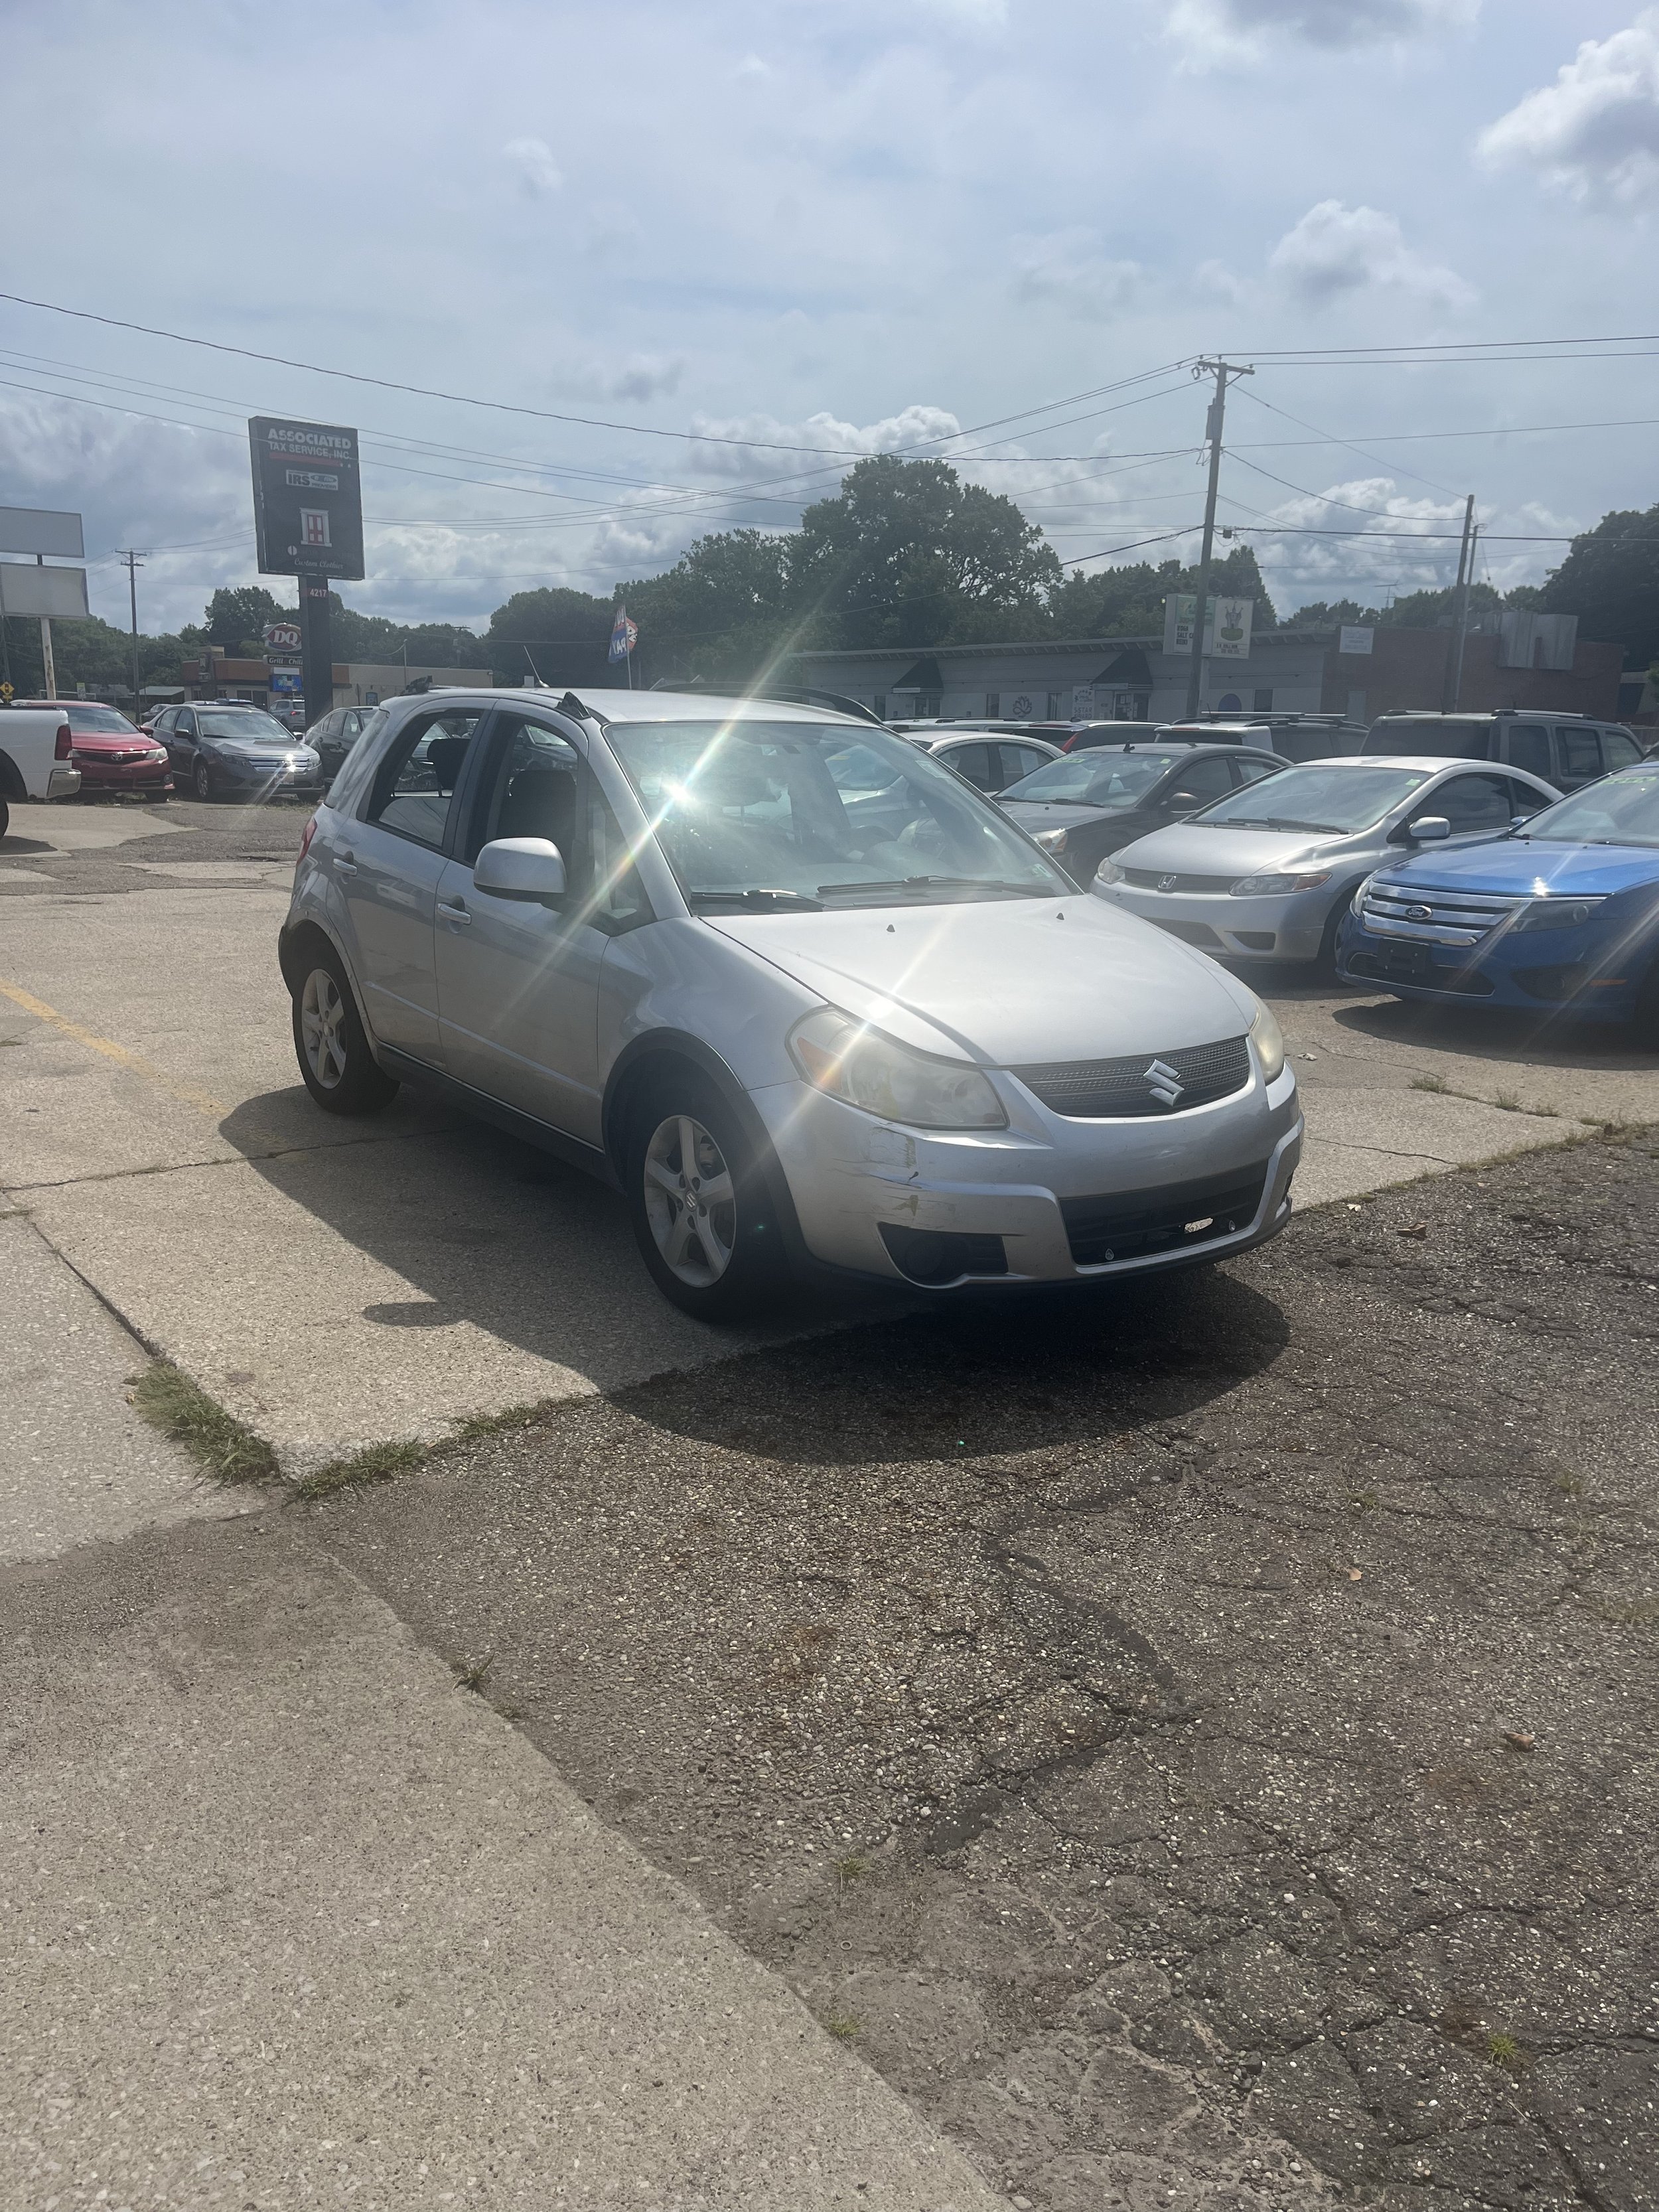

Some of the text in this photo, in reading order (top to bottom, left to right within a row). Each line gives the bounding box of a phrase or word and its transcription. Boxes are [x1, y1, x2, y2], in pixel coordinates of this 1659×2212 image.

[267, 428, 352, 449] ASSOCIATED
[269, 441, 287, 451] TAX
[288, 474, 310, 486] IRS
[273, 630, 298, 646] DQ
[1408, 907, 1425, 917] Ford
